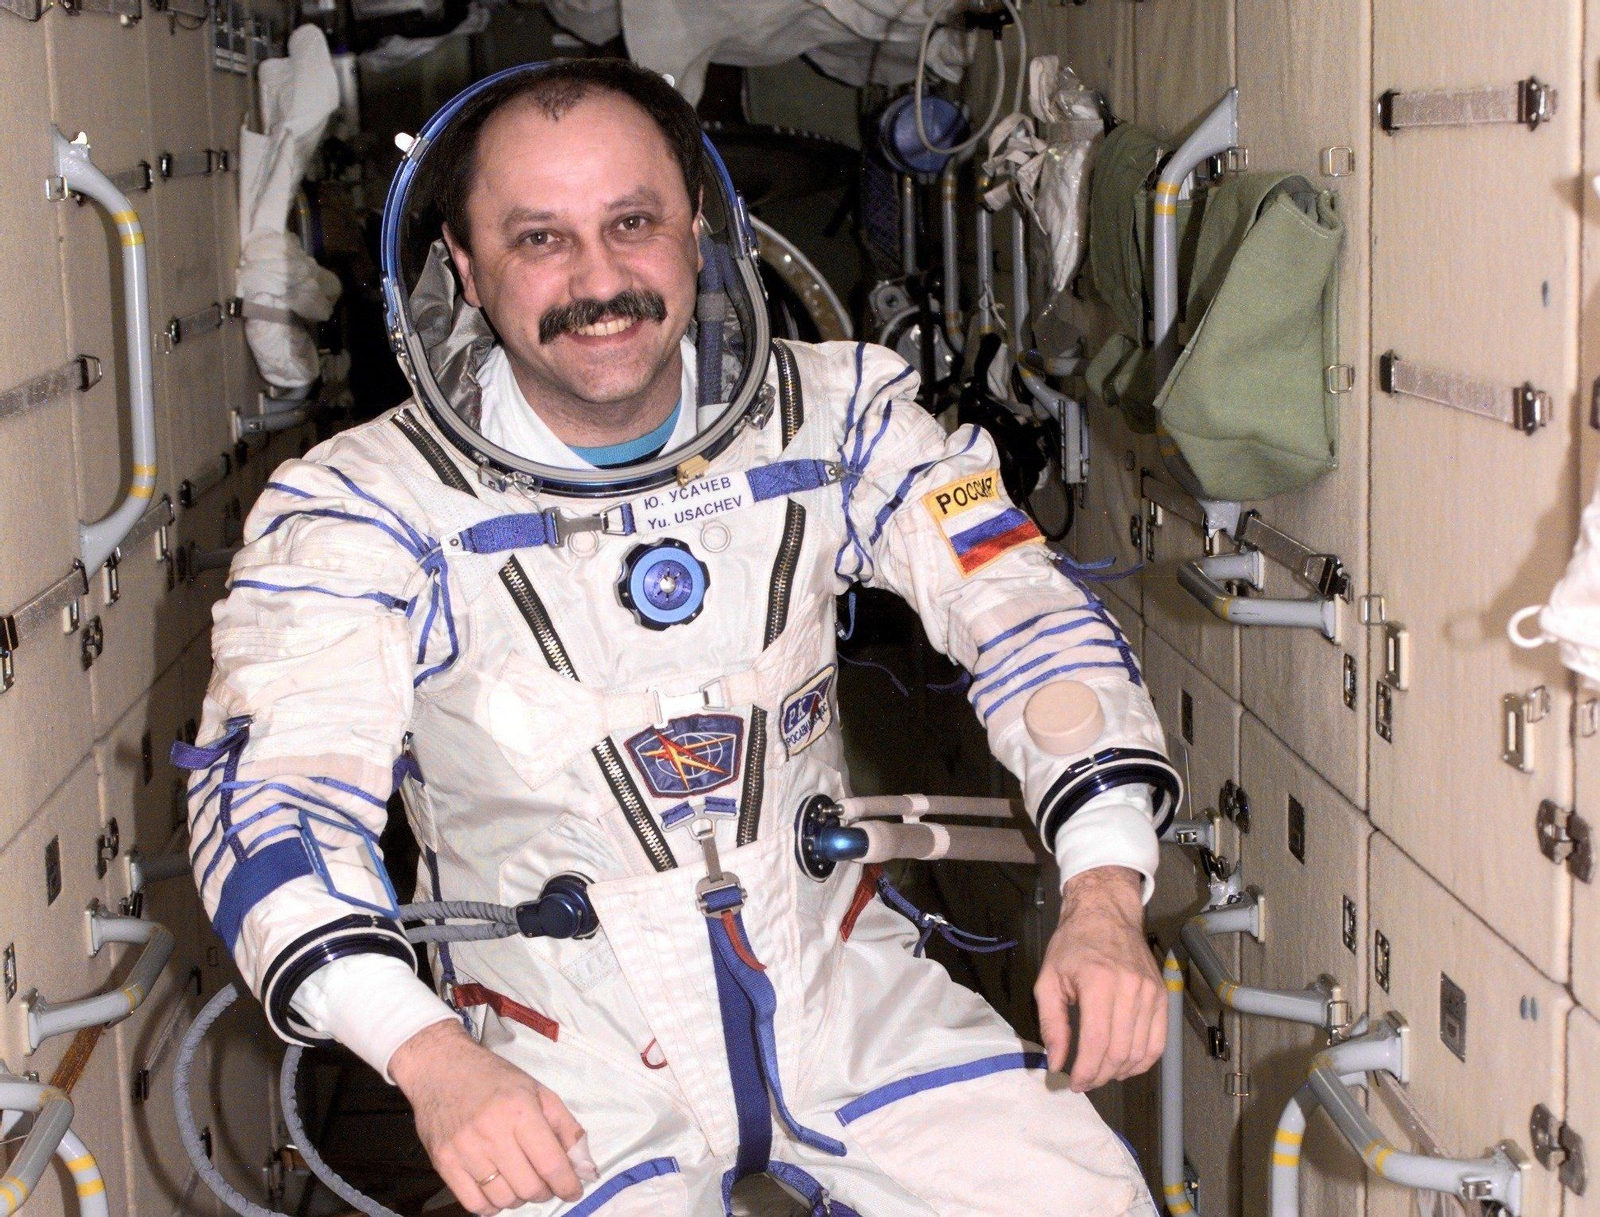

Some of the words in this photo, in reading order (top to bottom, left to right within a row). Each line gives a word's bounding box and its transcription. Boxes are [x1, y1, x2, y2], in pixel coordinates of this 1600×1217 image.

[644, 496, 664, 510] Ю.
[669, 476, 731, 503] УСАЧЕВ
[648, 518, 670, 530] Yu.
[674, 495, 742, 524] USACHEV
